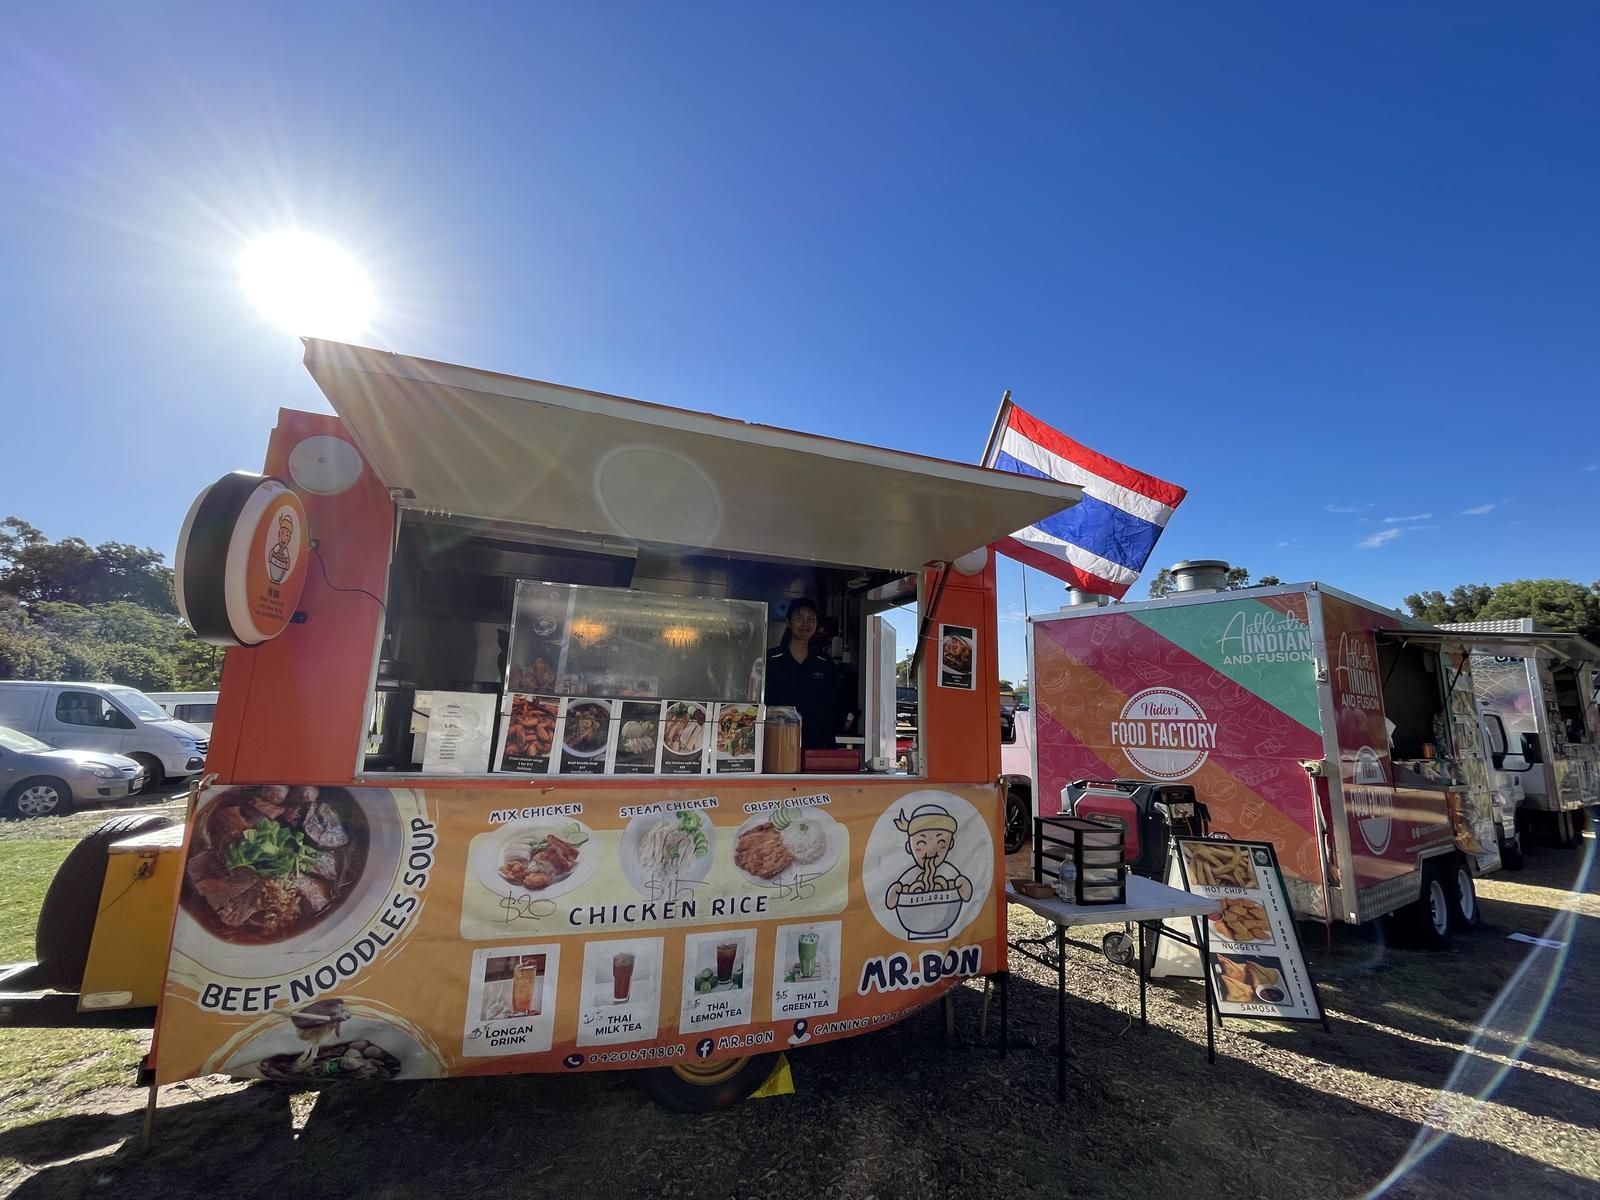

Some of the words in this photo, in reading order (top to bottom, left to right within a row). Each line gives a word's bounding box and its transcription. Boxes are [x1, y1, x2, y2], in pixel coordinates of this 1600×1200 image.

[1216, 610, 1308, 654] Authentic
[1247, 631, 1311, 653] INDIAN
[1223, 655, 1252, 665] AND
[1257, 651, 1312, 663] FUSION
[1350, 667, 1378, 698] INDIAN
[1342, 693, 1355, 708] AND
[1357, 695, 1380, 710] FUSION
[1111, 721, 1147, 745] FOOD
[1151, 722, 1218, 748] FACTORY
[490, 809, 519, 822] MIX
[521, 803, 583, 819] CHICKEN
[620, 804, 662, 817] STEAM
[666, 798, 718, 812] CHICKEN
[744, 801, 782, 813] CRISPY
[784, 794, 831, 809] CHICKEN
[642, 874, 709, 902] $15
[773, 872, 823, 901] $15
[1224, 887, 1248, 896] CHIPS
[200, 982, 281, 1012] BEEF
[290, 893, 416, 1003] NOODLES
[403, 817, 434, 888] SOUP
[492, 891, 557, 924] $20
[569, 901, 697, 926] CHICKEN
[711, 895, 769, 916] RICE
[1222, 942, 1261, 952] NUGGETS
[859, 947, 981, 994] MR.BON
[707, 1001, 729, 1012] THAI
[782, 1002, 811, 1012] GREEN
[812, 1000, 829, 1009] TEA
[796, 992, 816, 1002] THAI
[690, 1011, 722, 1023] LEMON
[723, 1008, 742, 1018] TEA
[1240, 1003, 1277, 1014] SAMOSA
[608, 1014, 632, 1025] THAI
[814, 1017, 869, 1035] CANNING
[485, 1025, 534, 1039] LONGAN
[595, 1025, 620, 1036] MILK
[623, 1023, 642, 1033] TEA
[490, 1035, 526, 1047] DRINK
[718, 1030, 774, 1049] MR.BON
[589, 1044, 685, 1063] 0420699804
